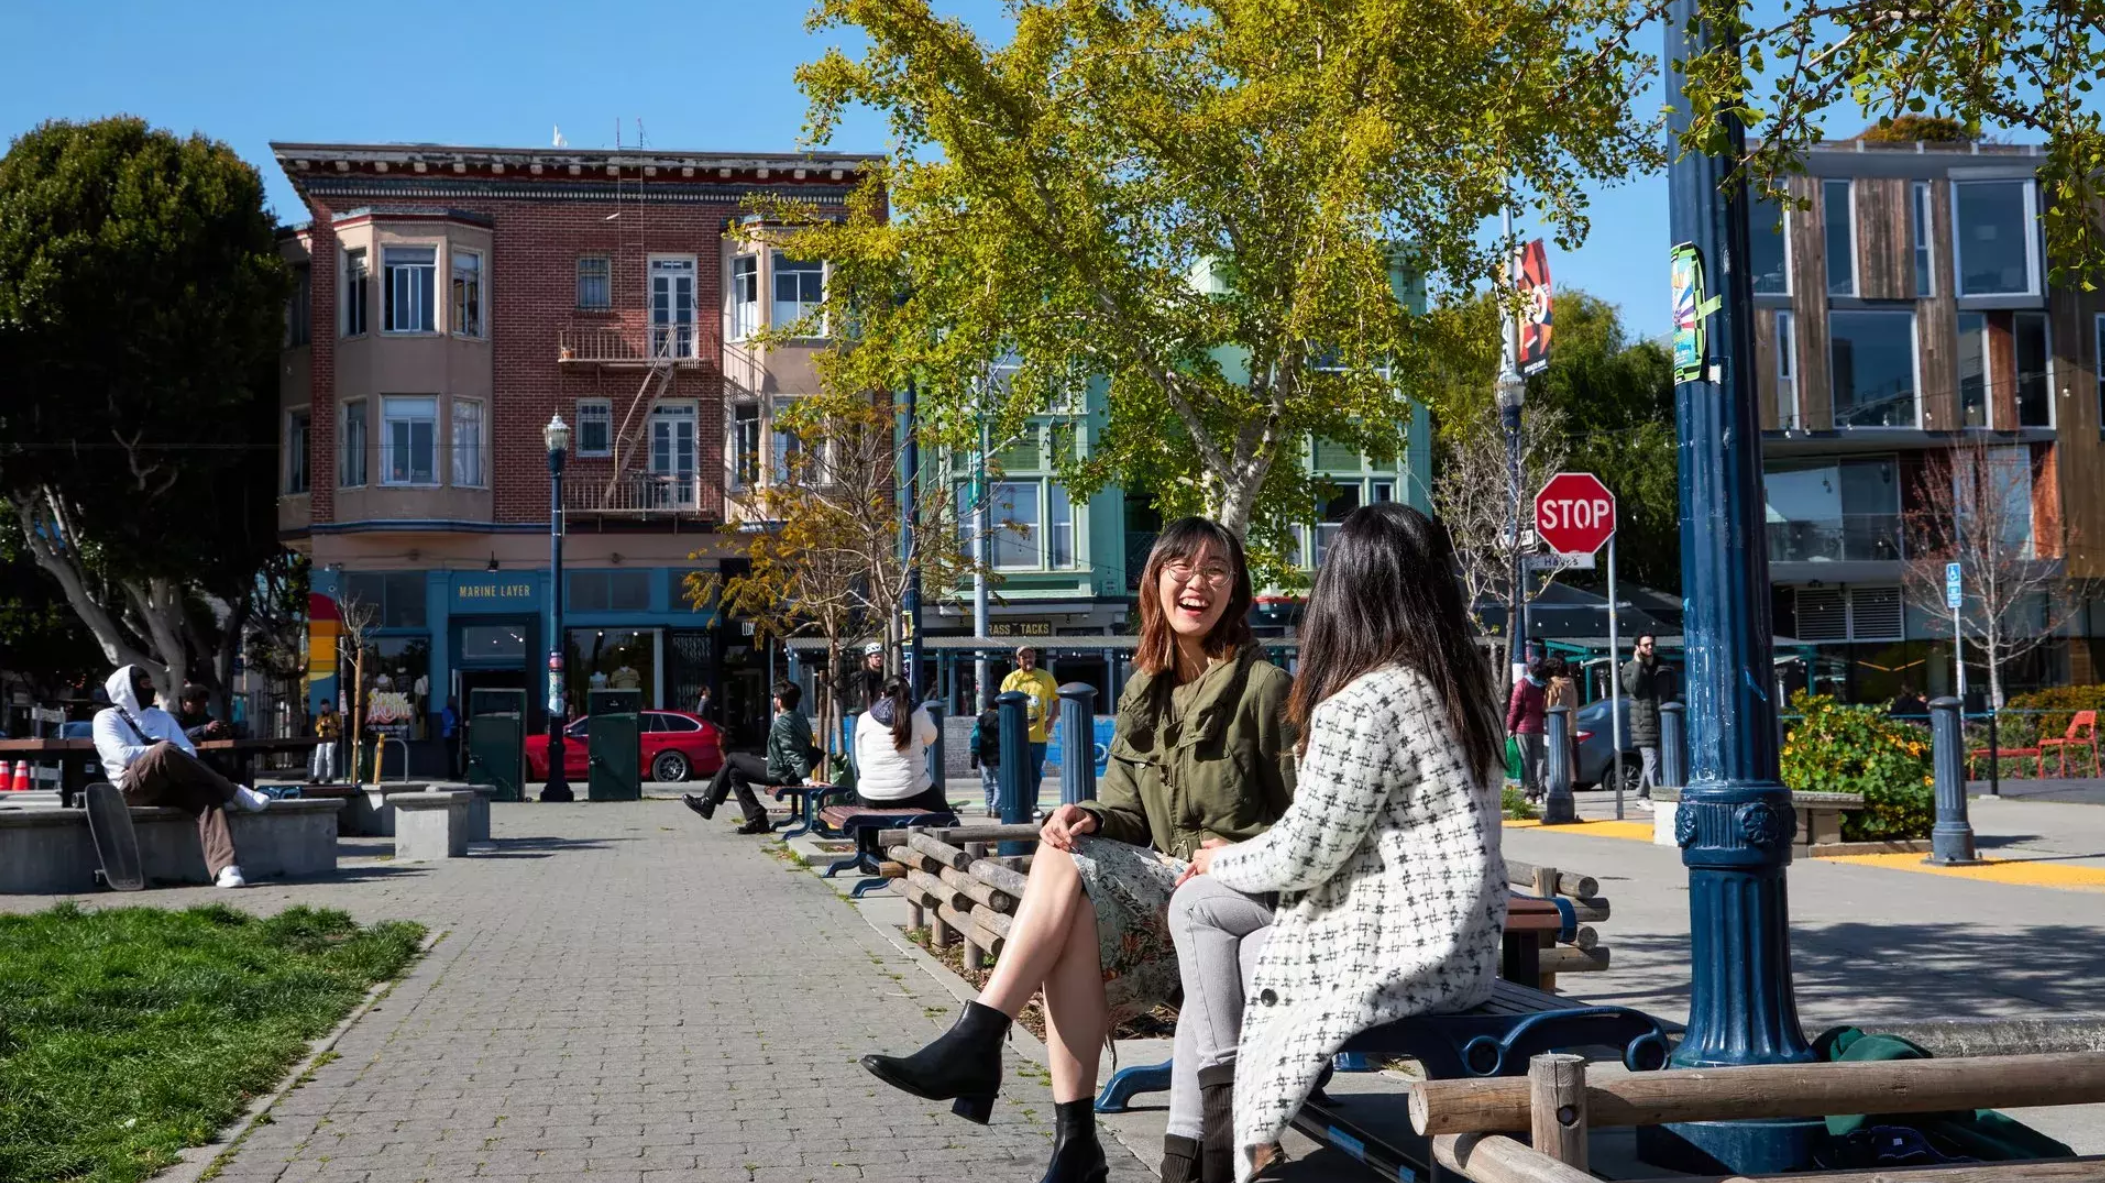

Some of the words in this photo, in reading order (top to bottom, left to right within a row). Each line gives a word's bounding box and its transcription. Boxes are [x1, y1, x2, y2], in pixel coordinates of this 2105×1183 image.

[1541, 498, 1610, 530] STOP
[459, 585, 496, 597] MARINE
[500, 584, 530, 597] LAYER
[988, 624, 1011, 635] RASS
[1020, 623, 1049, 635] TACKS
